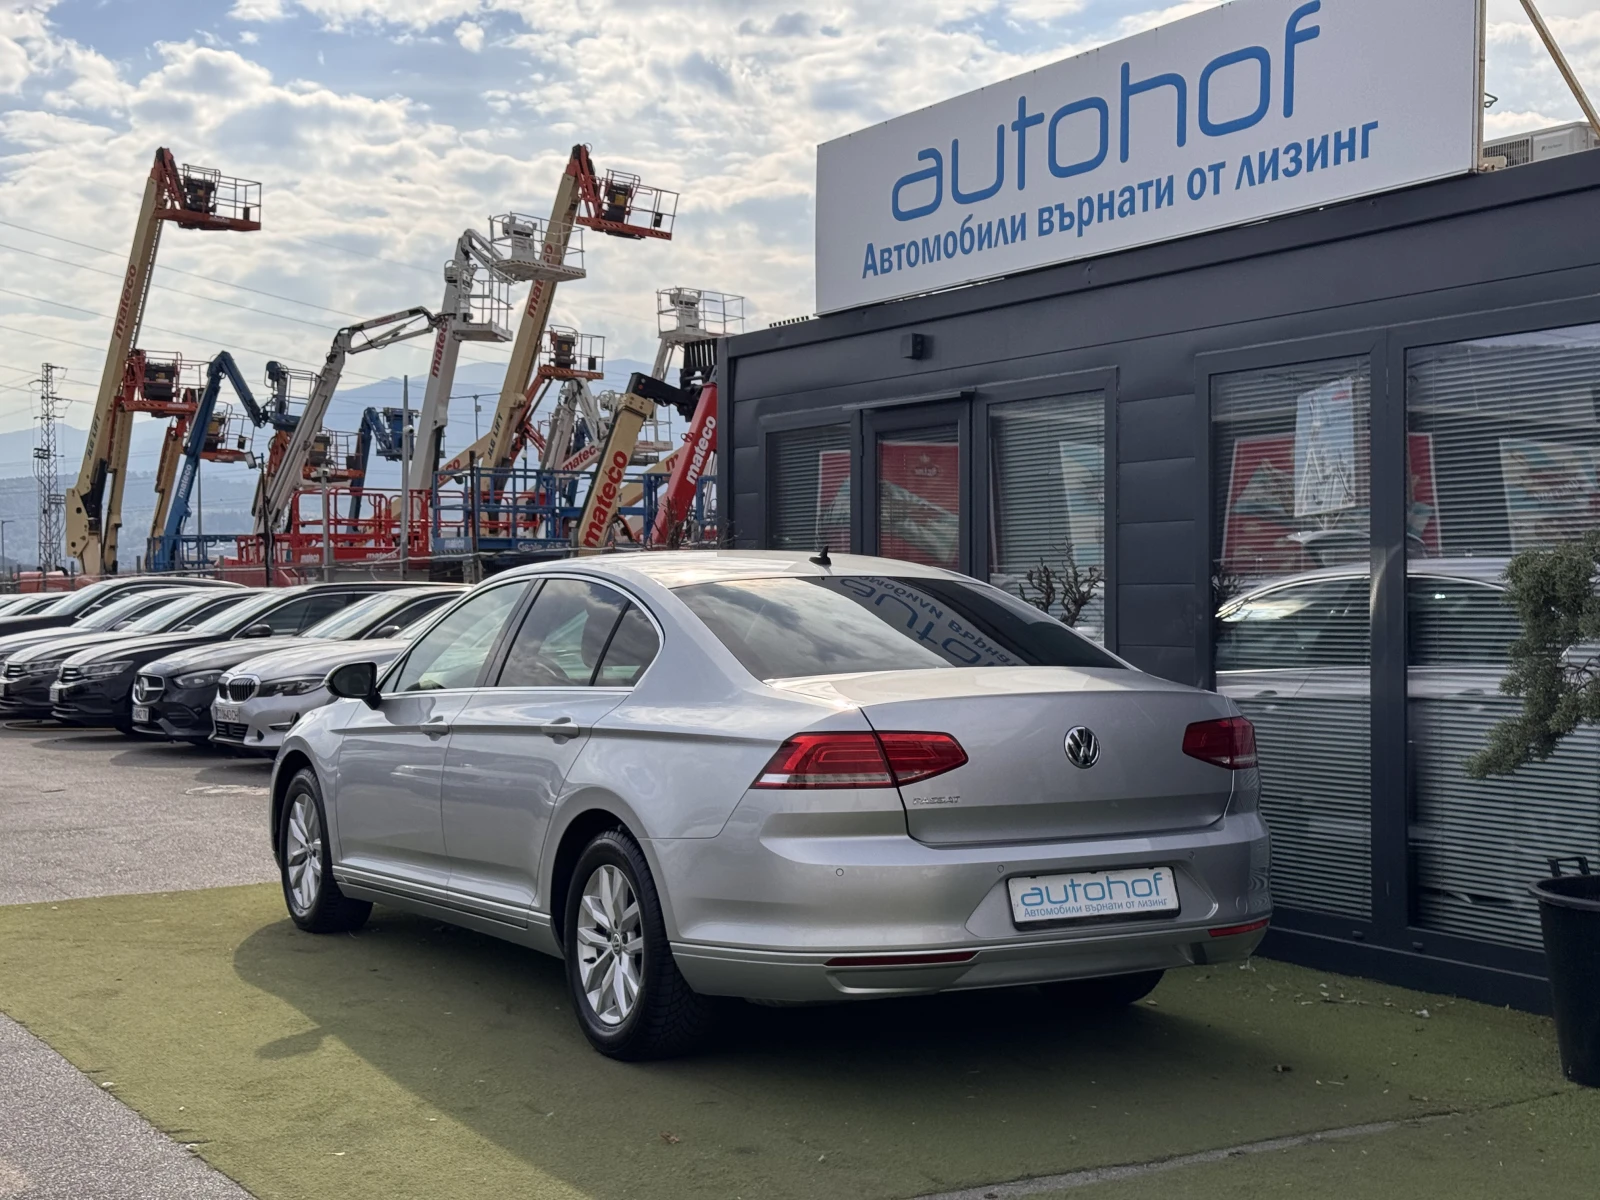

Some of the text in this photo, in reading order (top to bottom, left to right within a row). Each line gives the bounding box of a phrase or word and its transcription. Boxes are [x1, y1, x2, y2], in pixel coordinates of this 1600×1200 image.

[892, 0, 1321, 222] autohof
[862, 121, 1379, 279] Автомобили върнати от лизинг
[115, 264, 136, 339] mateco
[487, 412, 503, 460] JLG LIFT
[562, 445, 601, 475] matec
[686, 416, 716, 485] mateco
[178, 464, 192, 498] mateco
[583, 450, 628, 547] mateco
[913, 796, 960, 805] PASSAT
[1020, 872, 1163, 907] autohof
[1024, 898, 1168, 918] Автомобили върнати от лизинг
